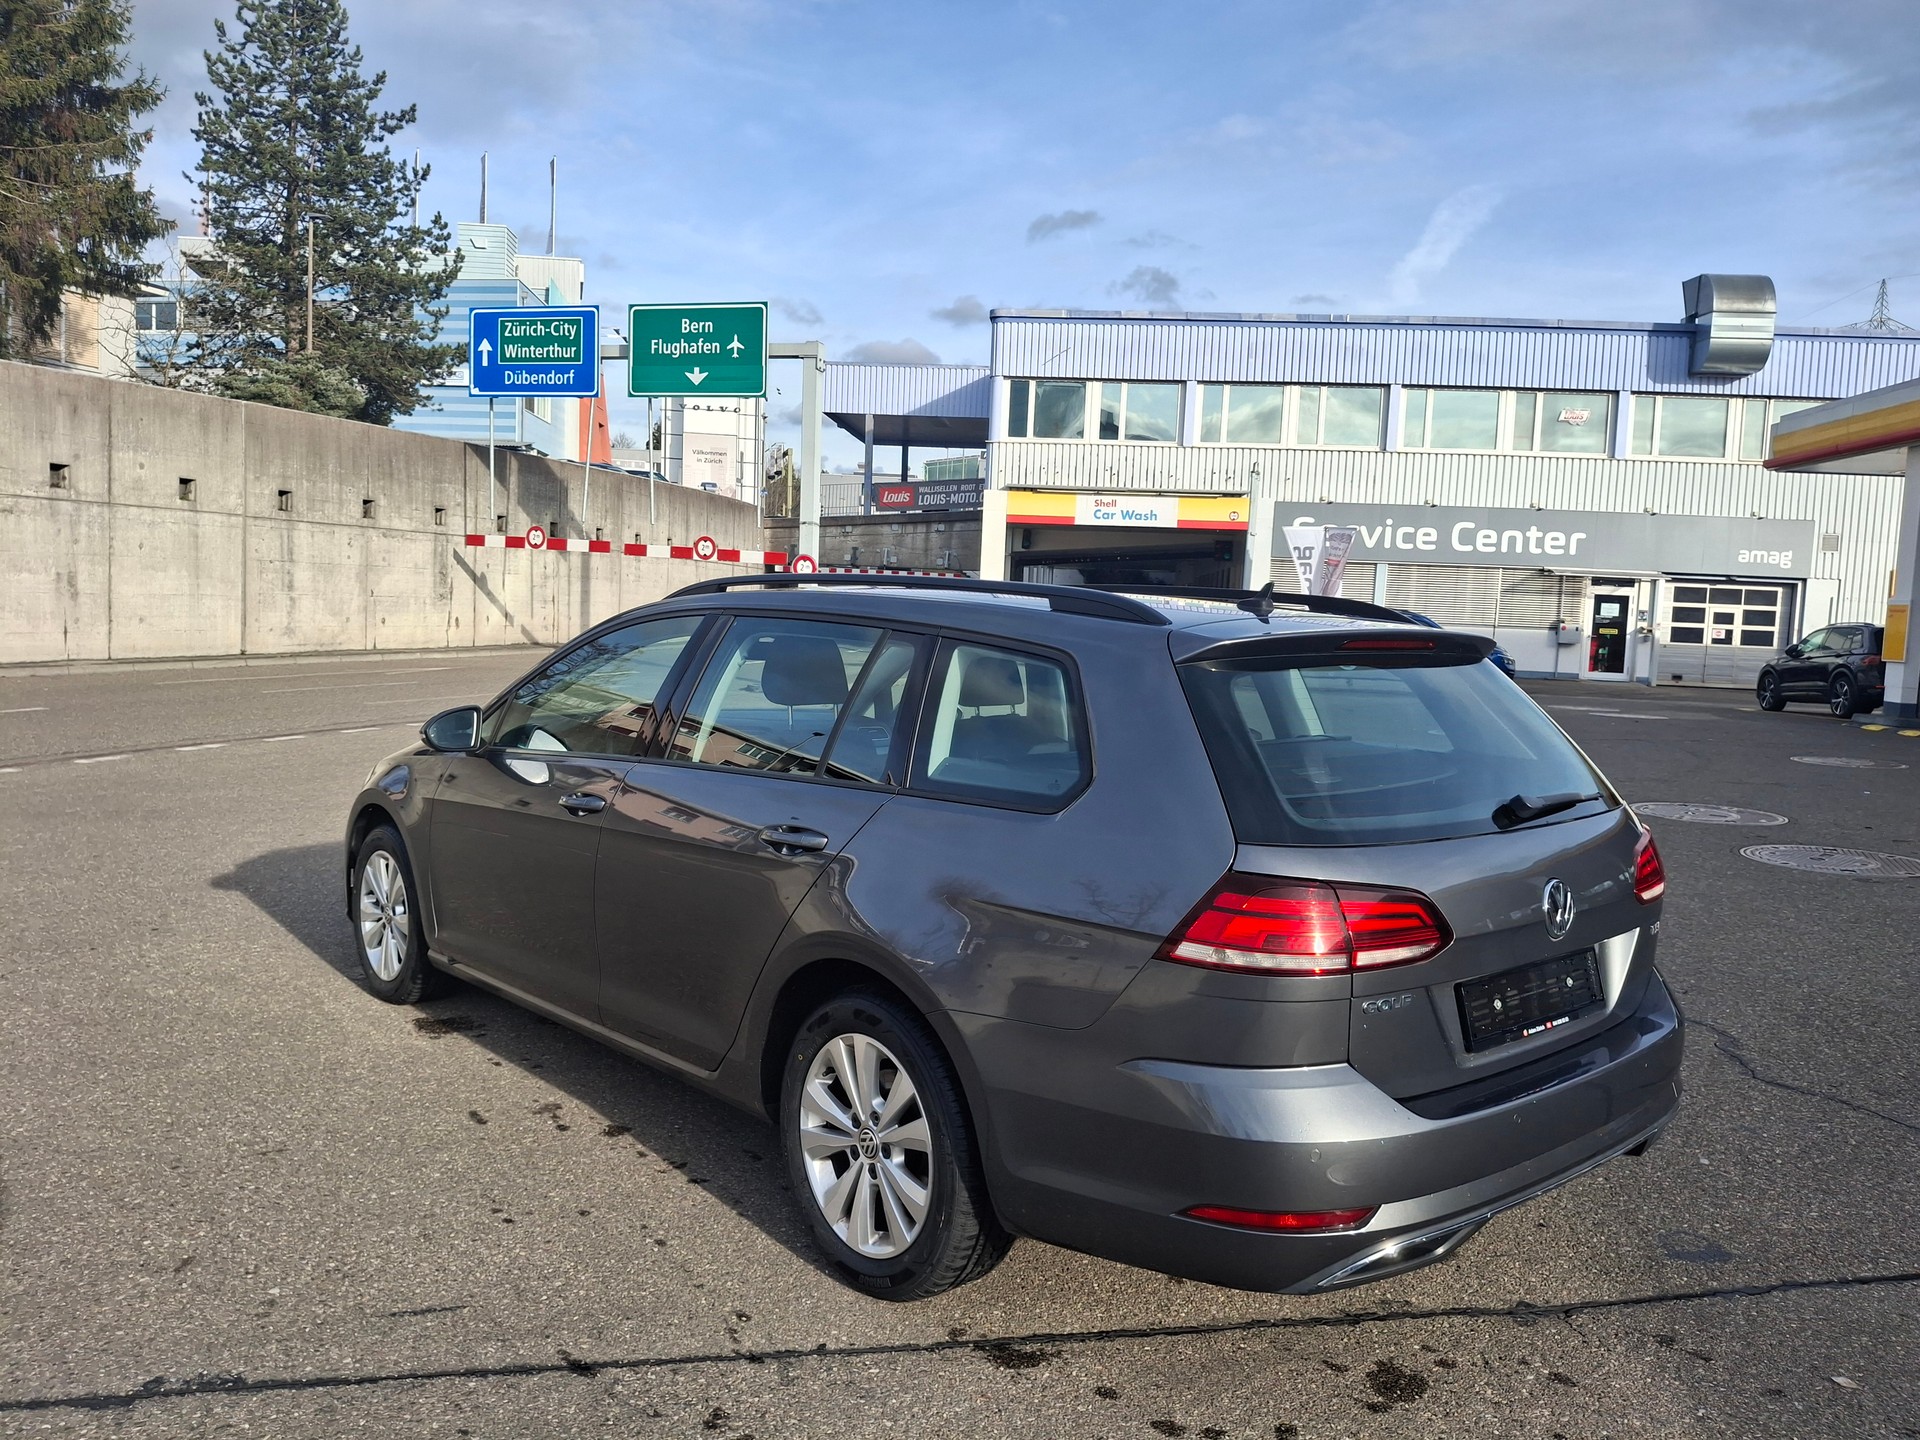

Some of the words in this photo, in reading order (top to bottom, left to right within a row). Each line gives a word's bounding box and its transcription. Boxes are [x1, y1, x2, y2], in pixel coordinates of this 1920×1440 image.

[504, 321, 577, 340] Zürich-City
[681, 318, 713, 333] Bern
[504, 343, 577, 358] Winterthur
[651, 338, 720, 358] Flughafen
[504, 369, 575, 385] Dübendorf
[679, 403, 741, 414] VOLVO
[704, 457, 723, 465] Zürich
[918, 484, 958, 493] WALLISELLEN
[882, 490, 911, 503] Louis
[1094, 499, 1117, 507] Shell
[1093, 509, 1116, 520] Car
[1120, 509, 1158, 521] Wash
[1292, 516, 1438, 550] vice
[1451, 521, 1587, 556] Center
[1738, 549, 1793, 569] amag
[1362, 994, 1412, 1014] GOLF
